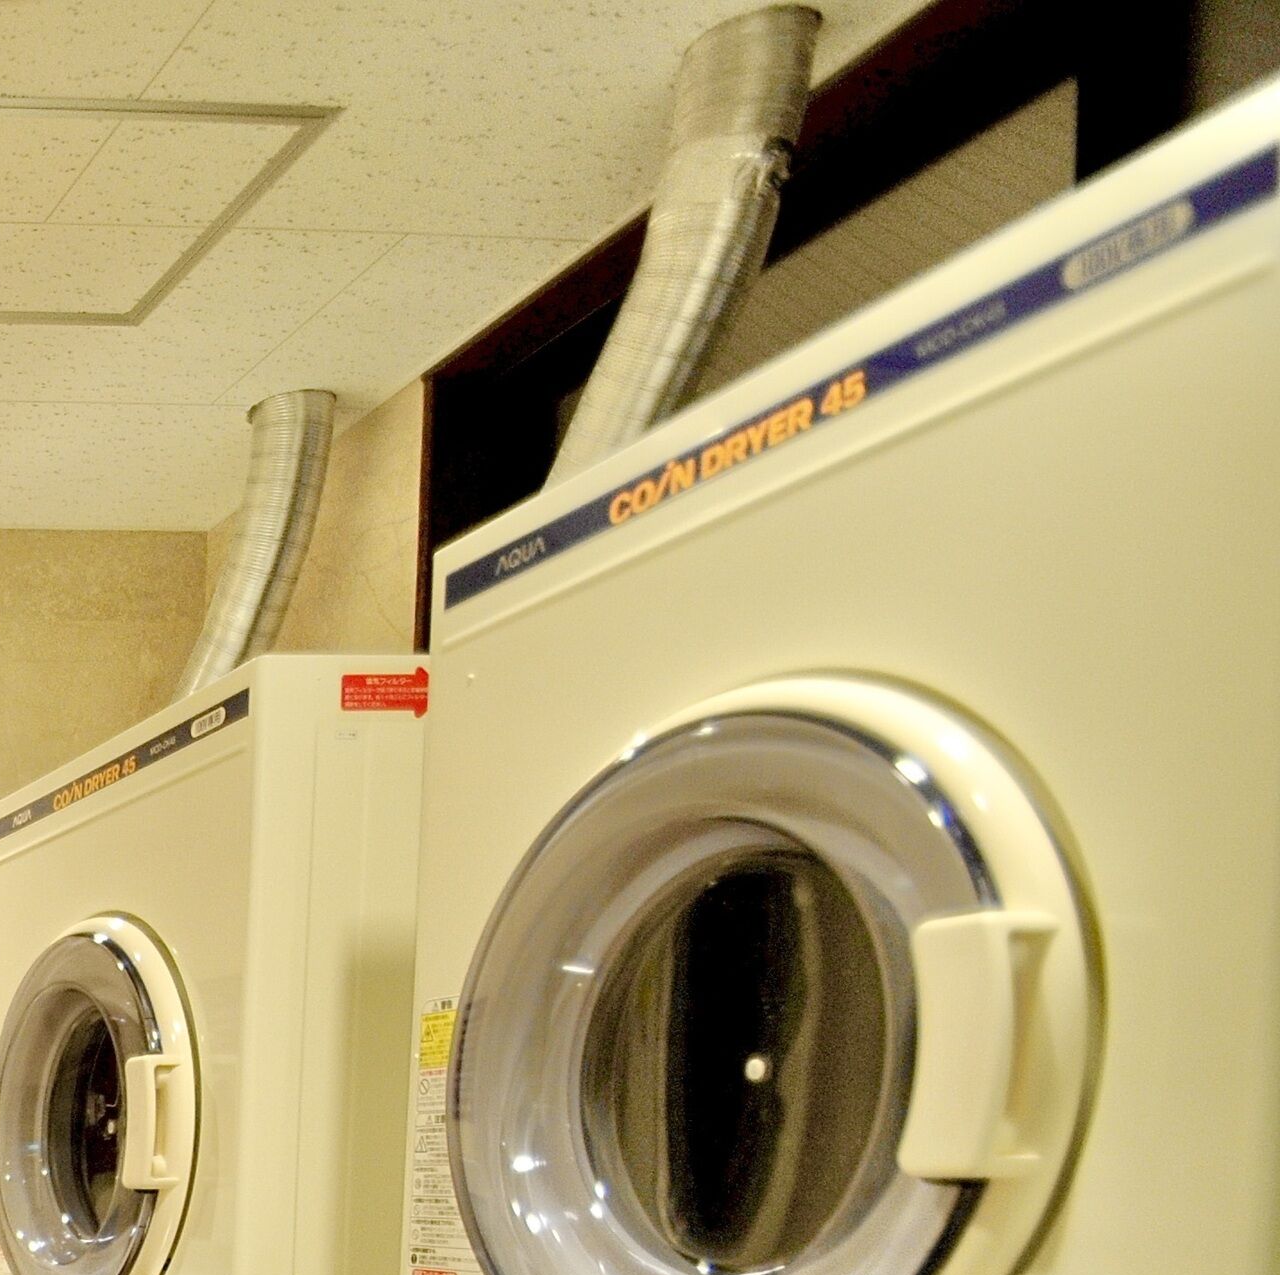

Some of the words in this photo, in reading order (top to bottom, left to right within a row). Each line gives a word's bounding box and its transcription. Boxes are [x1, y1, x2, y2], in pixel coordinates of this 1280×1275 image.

[608, 455, 697, 527] COIN
[699, 395, 815, 481] DRYER
[820, 367, 868, 418] 45
[494, 536, 548, 578] AQUA
[83, 763, 121, 798] DRYER
[121, 754, 138, 779] 45
[11, 808, 33, 829] AQUA
